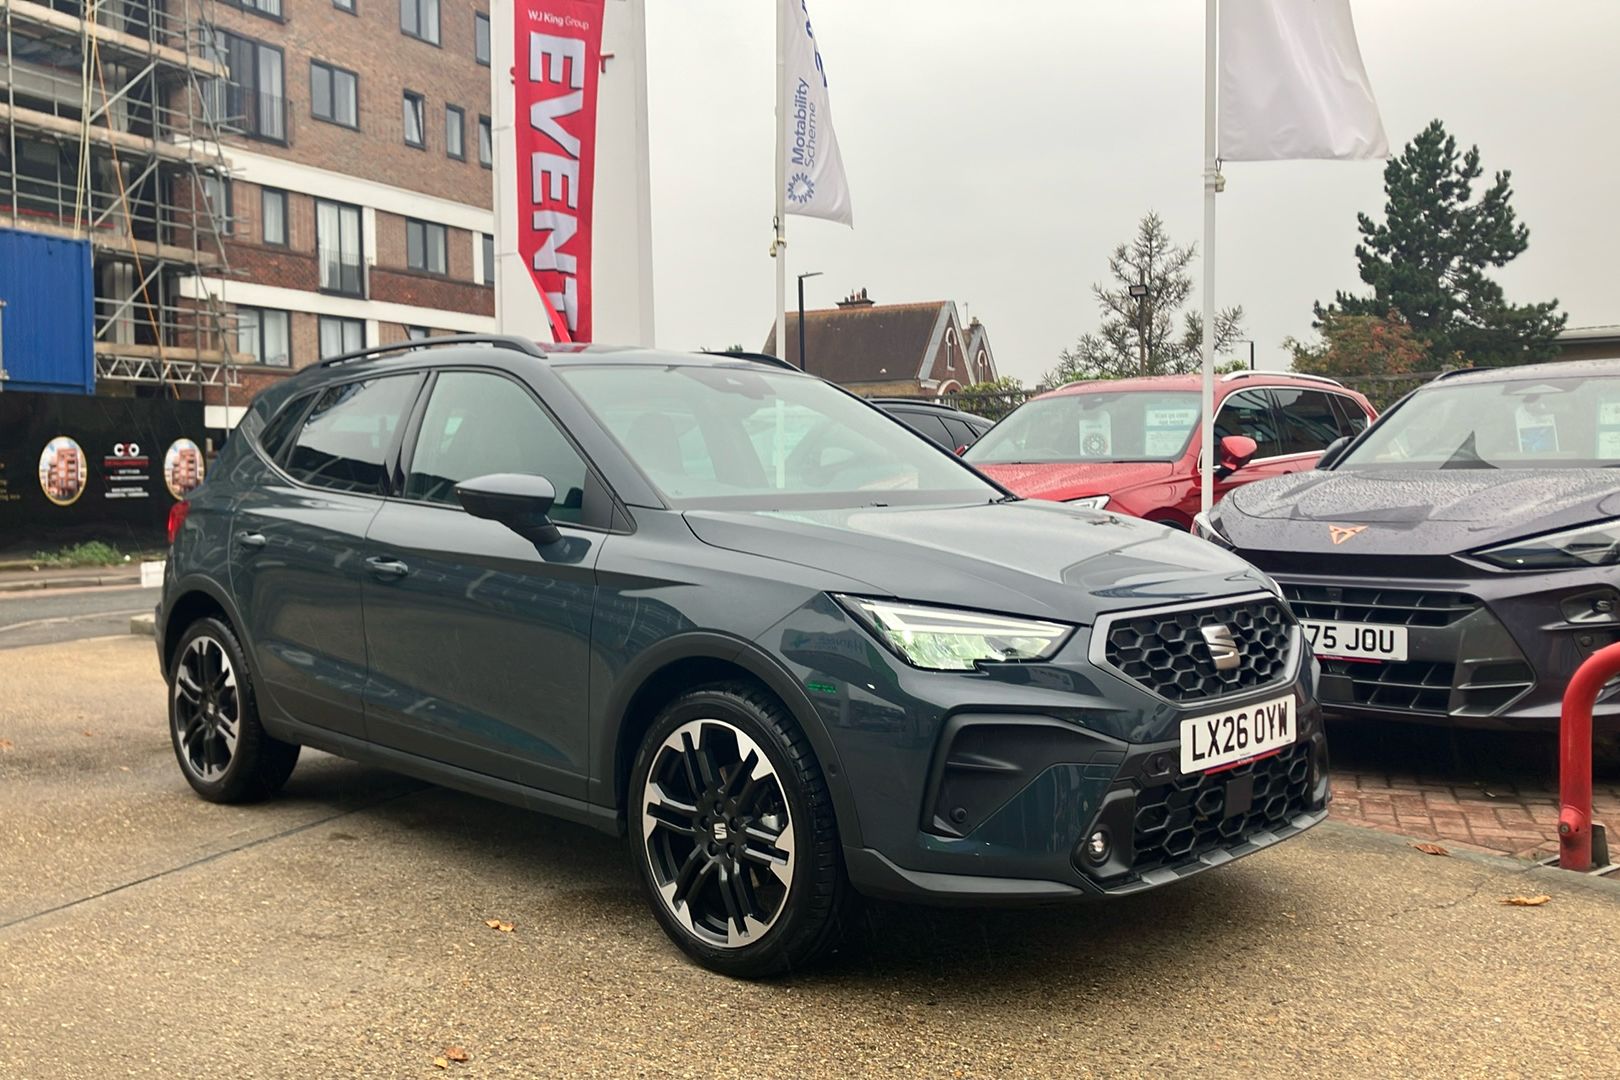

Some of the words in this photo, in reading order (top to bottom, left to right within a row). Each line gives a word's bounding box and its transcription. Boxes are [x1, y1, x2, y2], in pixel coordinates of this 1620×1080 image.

[528, 9, 543, 22] WJ
[544, 11, 564, 27] King
[564, 15, 590, 31] Group
[792, 77, 810, 165] Motability
[804, 102, 816, 169] Scheme
[529, 31, 586, 332] EVENT
[1301, 624, 1337, 649] 75
[1345, 627, 1395, 653] JOU
[1192, 713, 1249, 762] LX26
[1254, 701, 1288, 744] OYW
